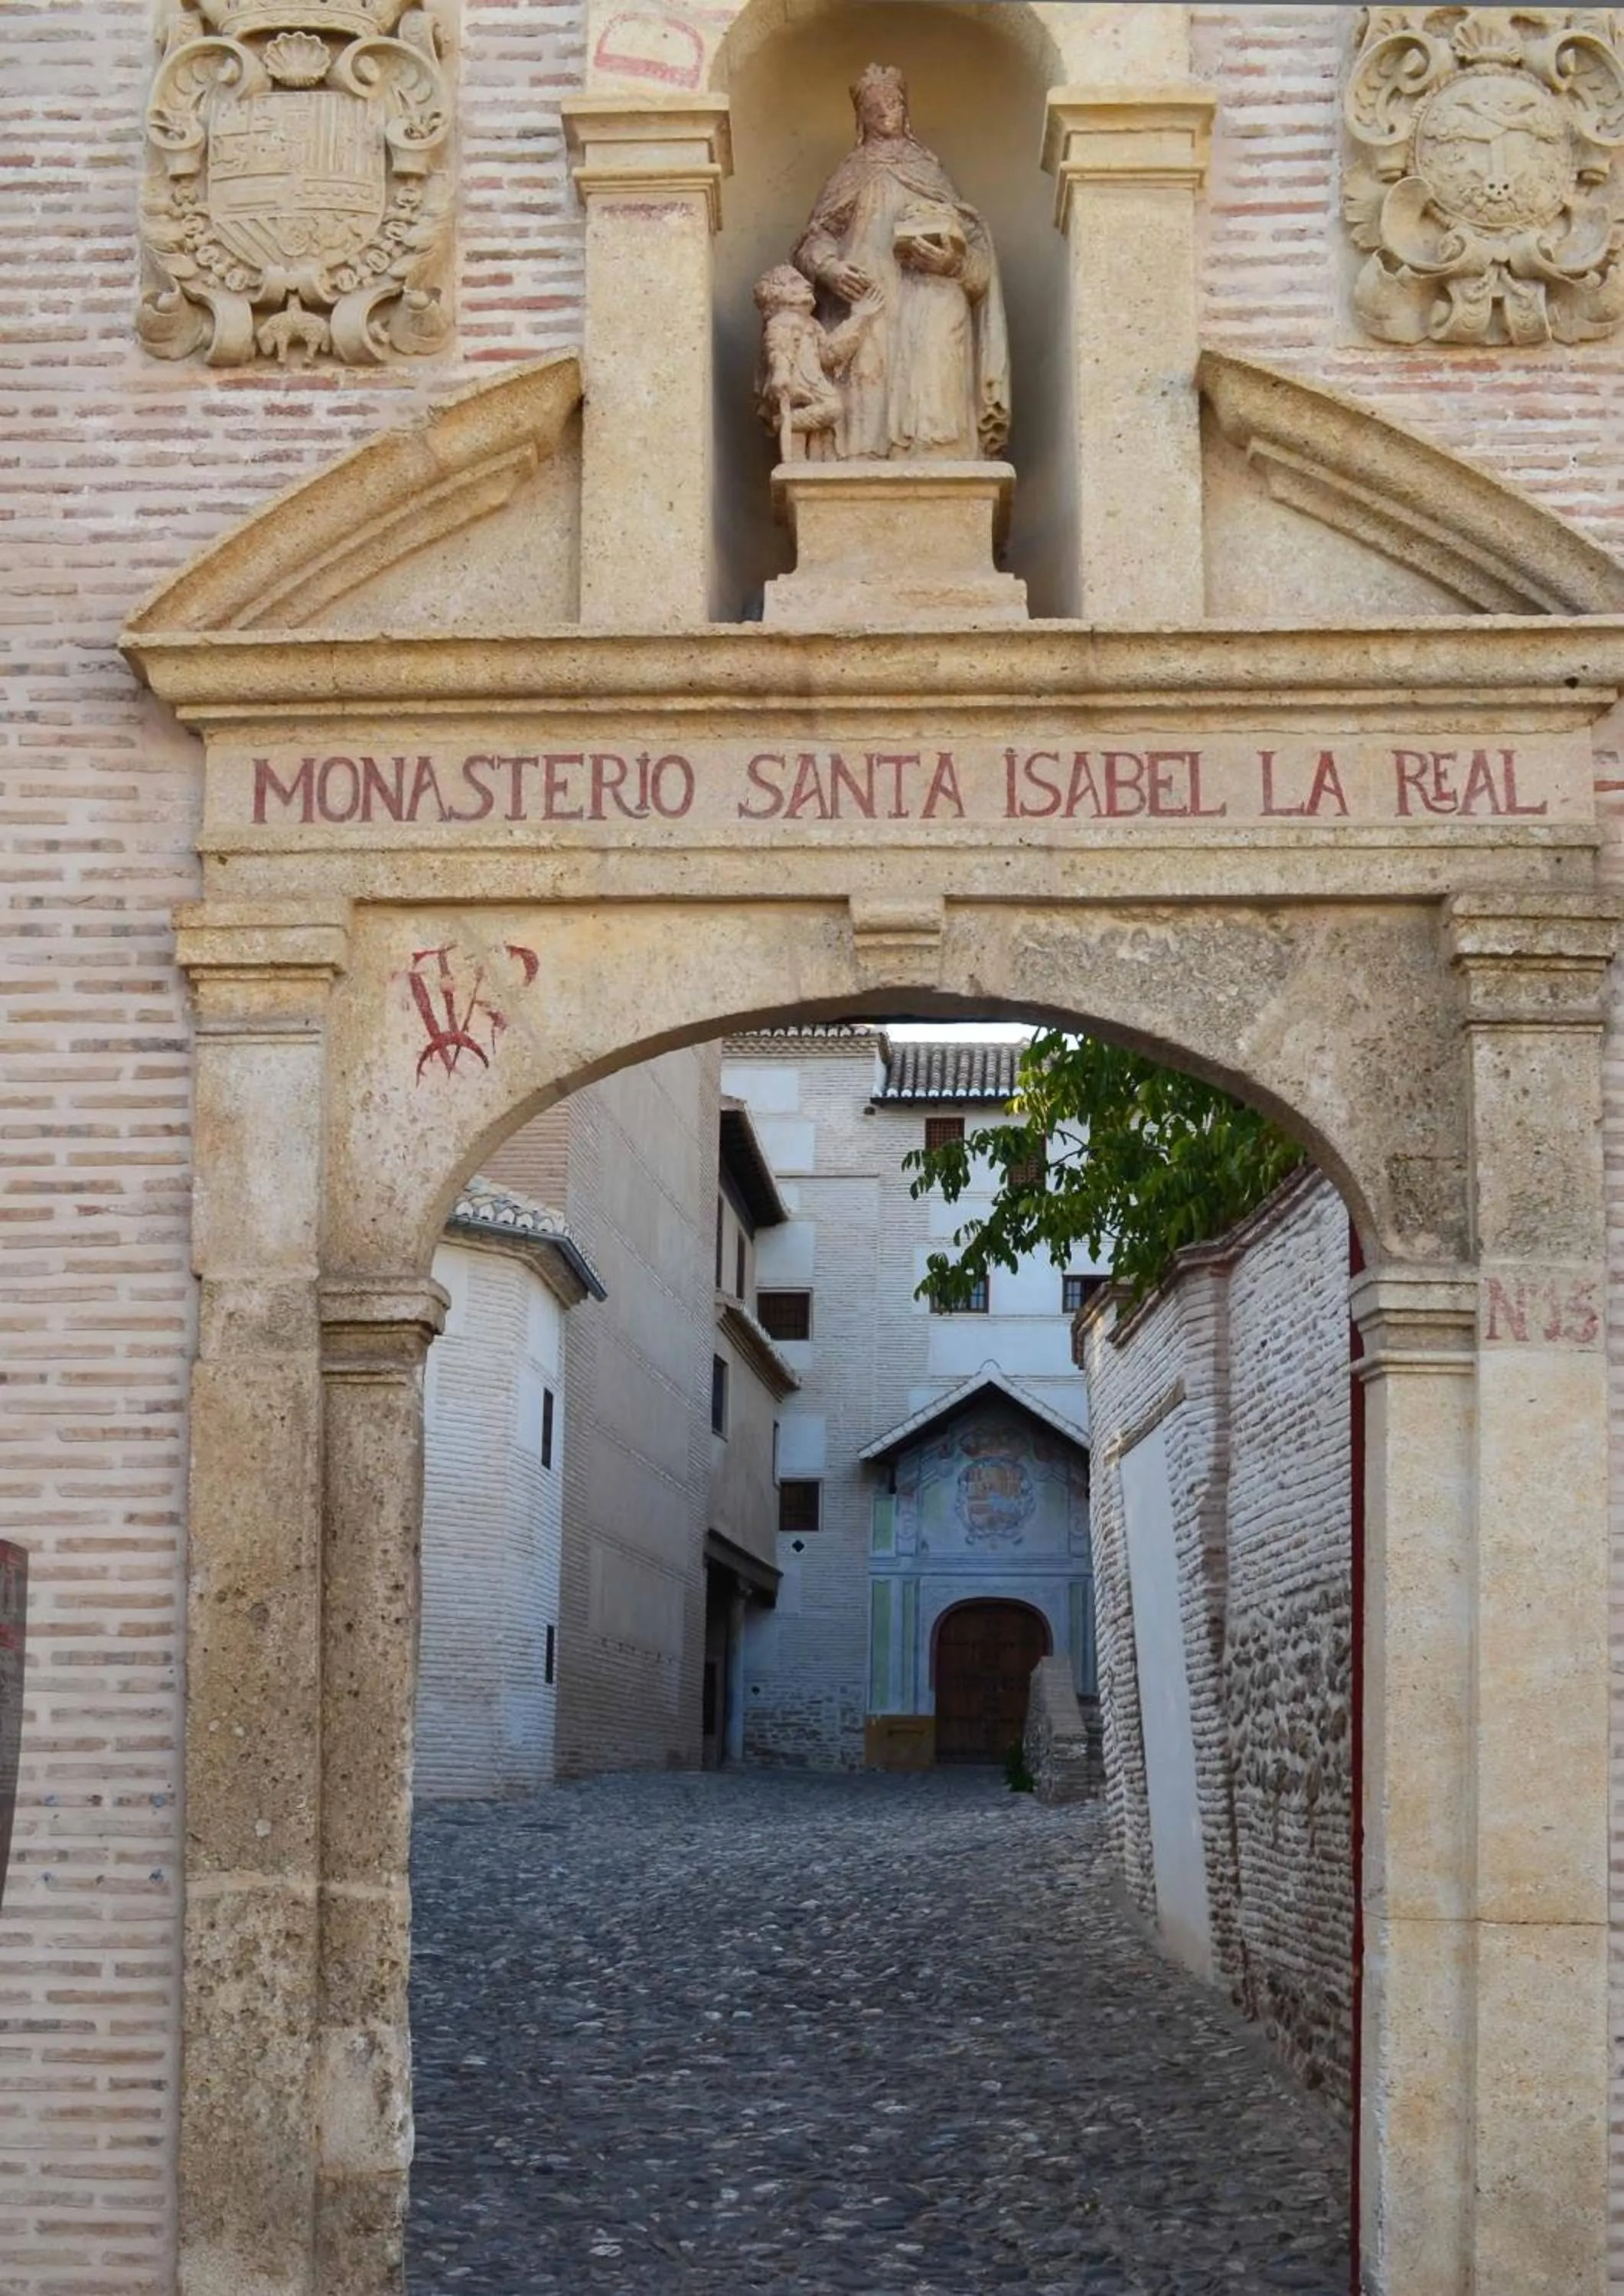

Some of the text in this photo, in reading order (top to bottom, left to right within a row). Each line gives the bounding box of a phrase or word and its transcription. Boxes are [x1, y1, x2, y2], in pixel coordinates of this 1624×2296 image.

[253, 747, 1548, 823] MONASTERIO SANTA ISABEL LA REAL
